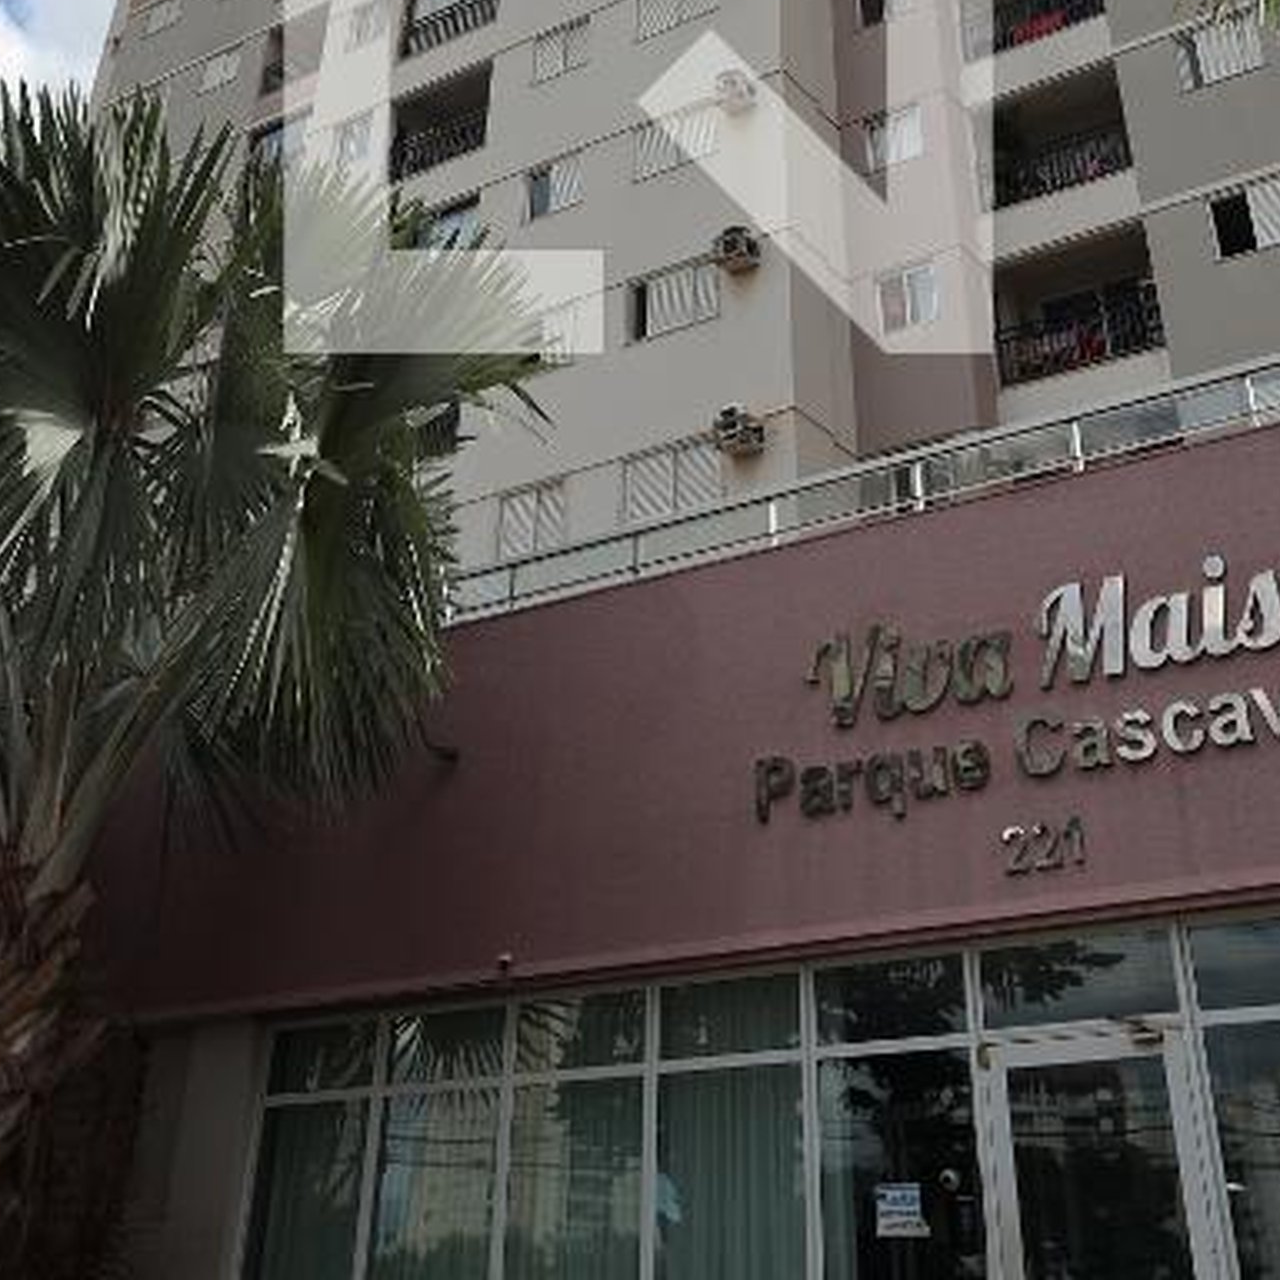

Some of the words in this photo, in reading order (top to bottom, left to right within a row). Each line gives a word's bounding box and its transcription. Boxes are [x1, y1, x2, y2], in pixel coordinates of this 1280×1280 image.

[806, 622, 1014, 728] Viva
[754, 738, 992, 822] Parque
[1001, 817, 1086, 877] 221
